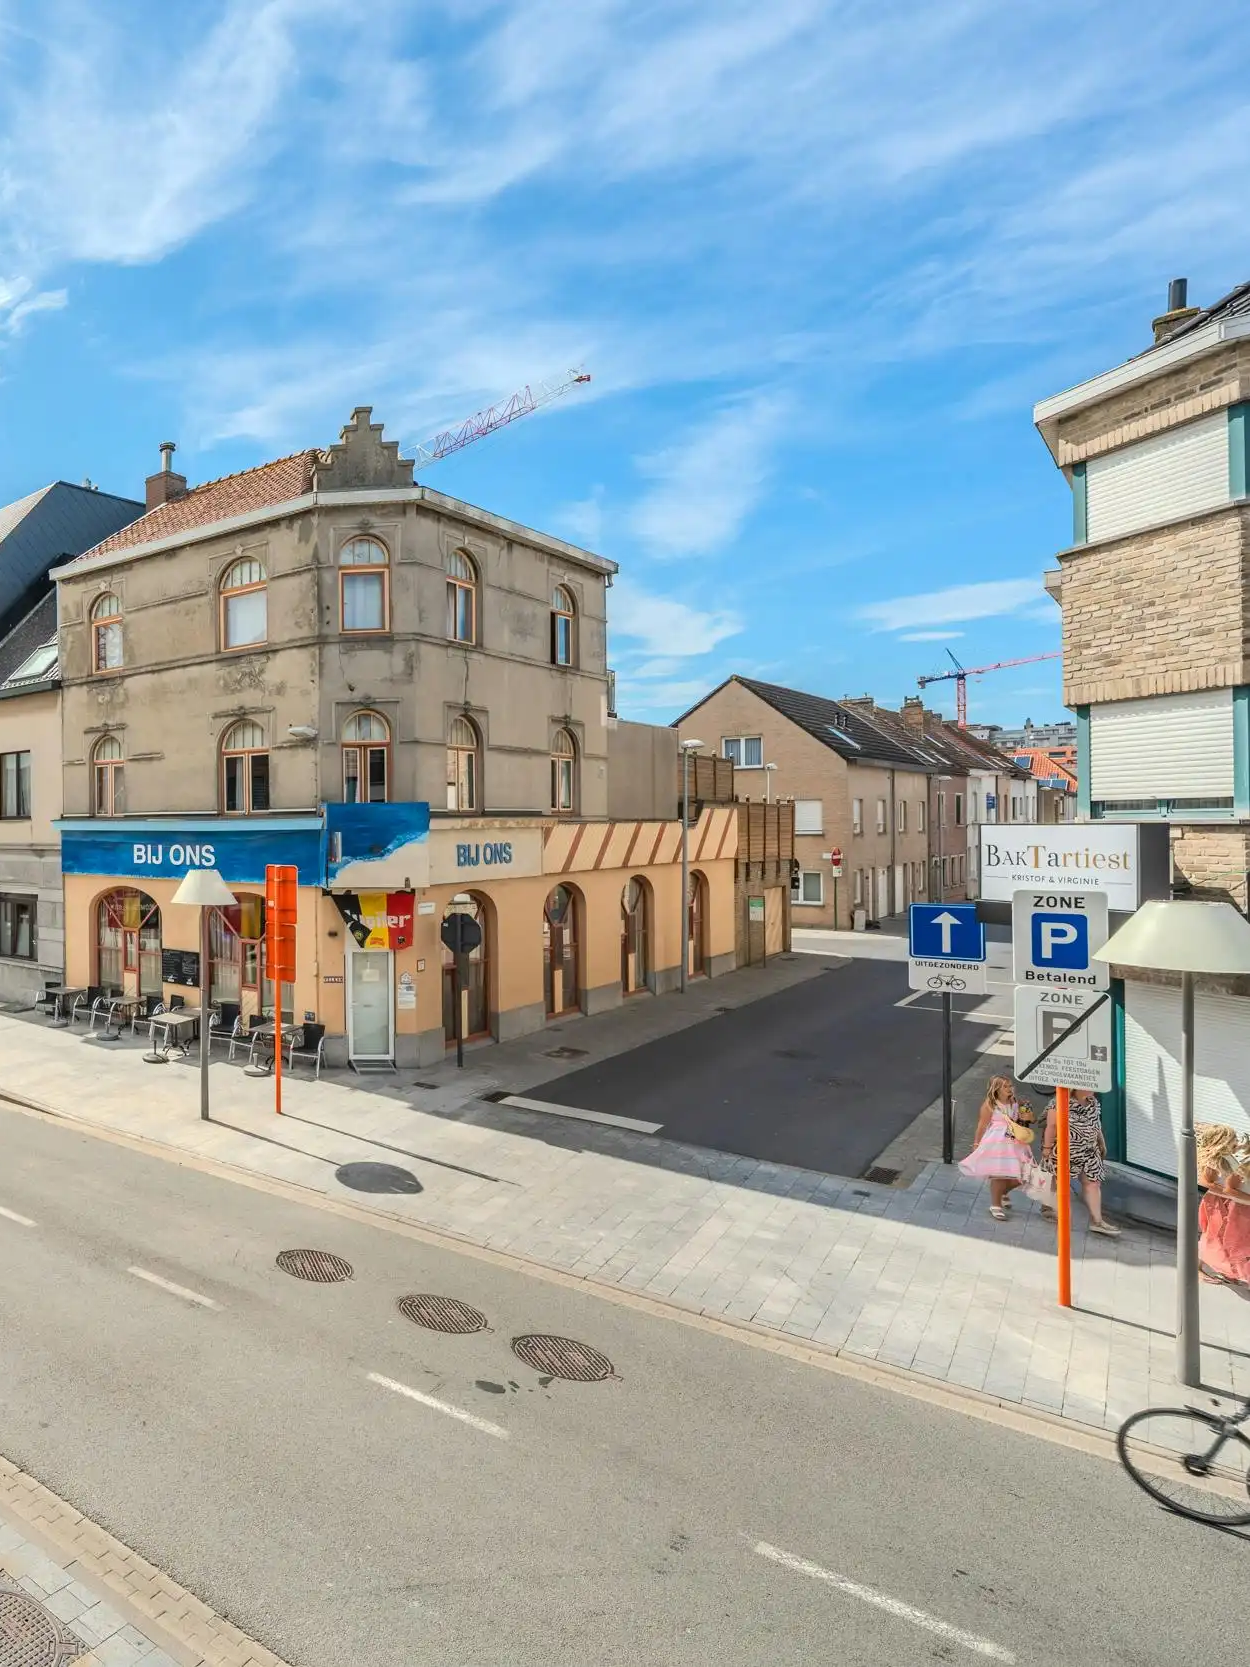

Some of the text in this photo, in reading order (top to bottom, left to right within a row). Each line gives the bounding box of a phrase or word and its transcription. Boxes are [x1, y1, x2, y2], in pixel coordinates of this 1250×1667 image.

[133, 844, 216, 867] BIJ ONS
[456, 842, 513, 867] BIJ ONS
[1011, 874, 1100, 886] KRISTOF & VIRGINIE
[1033, 895, 1086, 909] ZONE
[1040, 921, 1078, 959] P
[914, 960, 979, 971] UITGEZONDERD
[1025, 970, 1097, 985] Betalend
[1040, 992, 1084, 1005] ZONE
